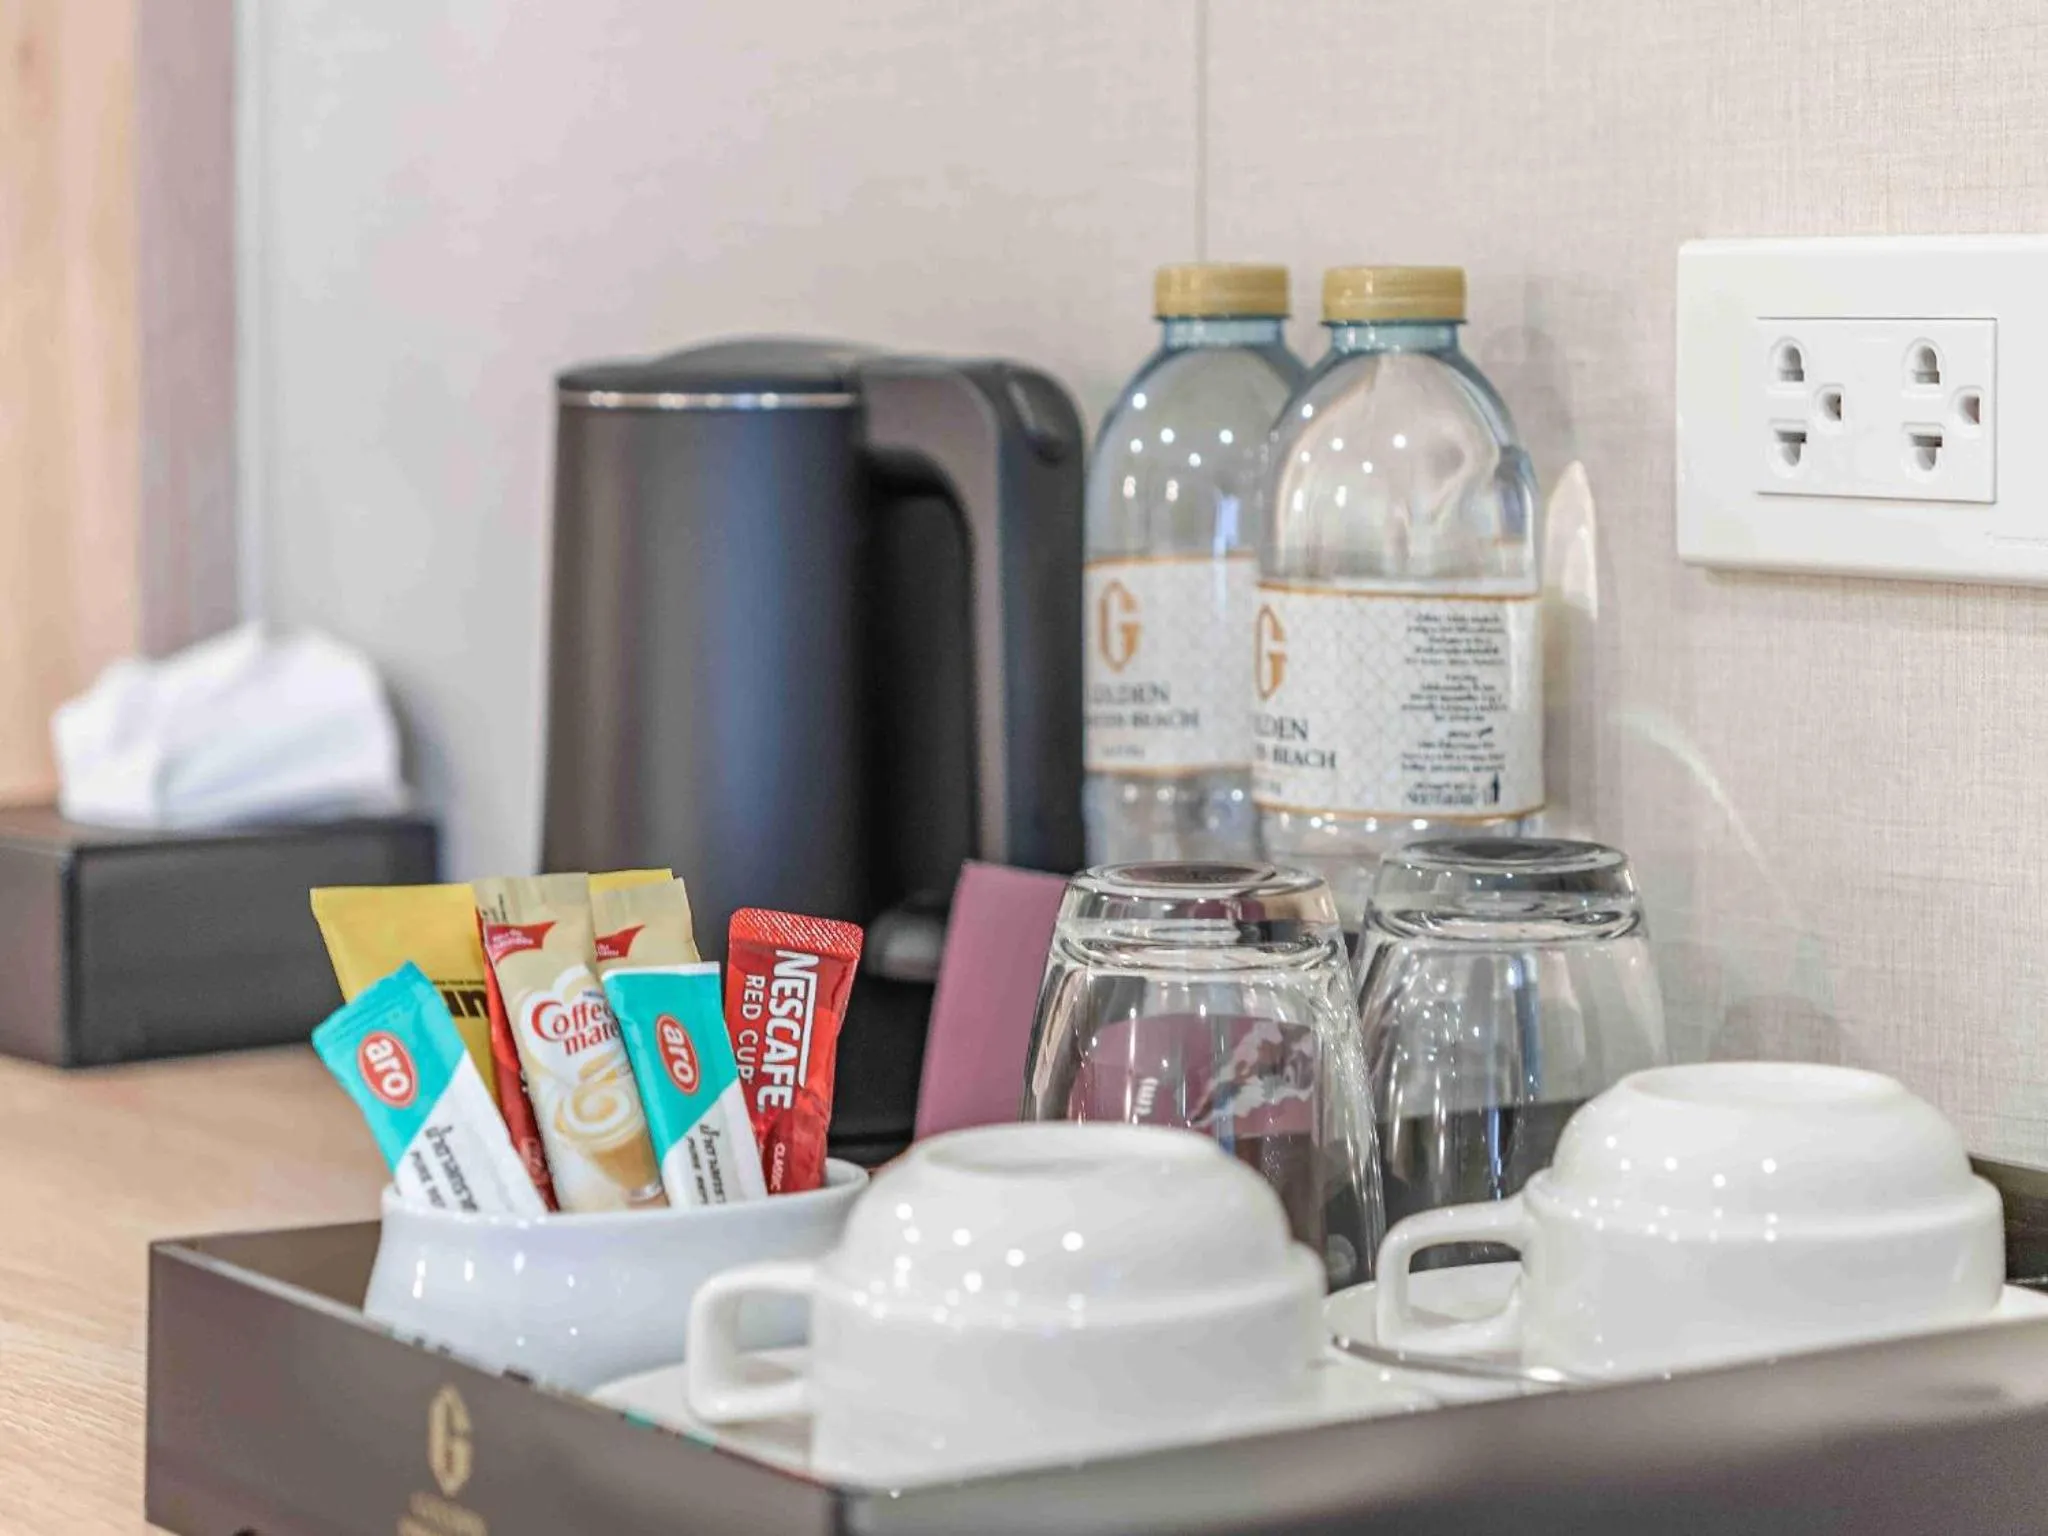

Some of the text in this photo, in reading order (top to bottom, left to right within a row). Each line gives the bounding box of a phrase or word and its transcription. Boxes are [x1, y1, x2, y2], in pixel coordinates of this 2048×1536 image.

[662, 1023, 694, 1083] aro
[732, 974, 767, 1082] RED CUP
[364, 1038, 410, 1098] aro
